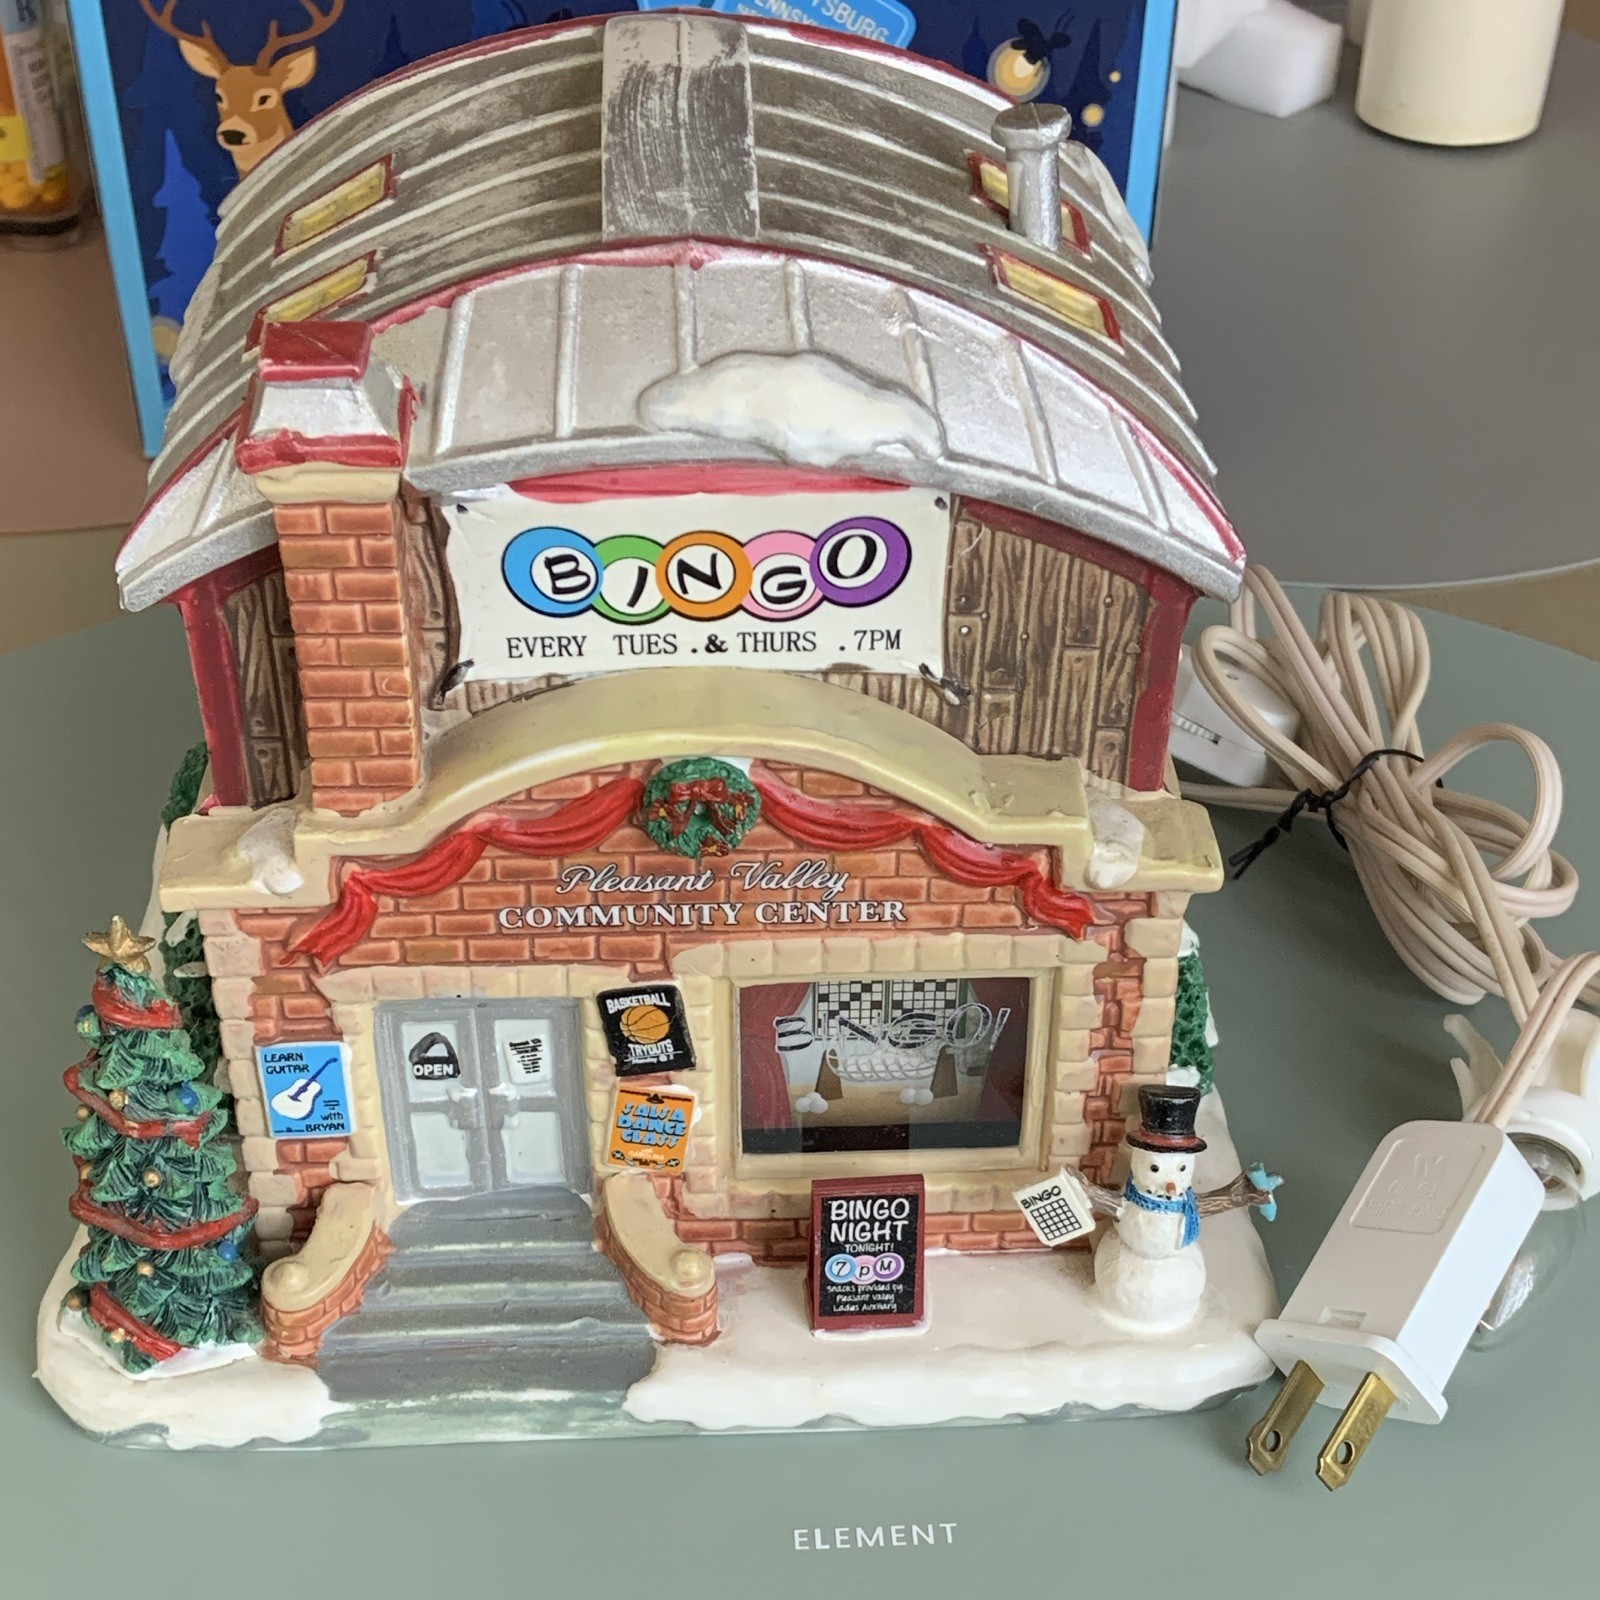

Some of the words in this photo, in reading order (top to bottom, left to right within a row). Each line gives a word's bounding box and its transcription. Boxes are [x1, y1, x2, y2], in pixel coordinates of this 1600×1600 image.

[812, 0, 890, 42] SBURG
[543, 533, 879, 609] BINGO
[506, 635, 588, 659] EVERY
[704, 633, 729, 654] &
[556, 862, 714, 894] Pleasant
[730, 860, 850, 899] Valley
[498, 902, 744, 929] COMMUNITY
[754, 900, 908, 925] CENTER
[605, 992, 671, 1014] BASKETBALL
[264, 1052, 304, 1063] LEARN
[627, 1039, 674, 1057] TRYOUTS
[265, 1064, 310, 1075] GUITAR
[413, 1063, 454, 1076] OPEN
[621, 1102, 686, 1123] SALSA
[305, 1122, 346, 1133] BRYAN
[616, 1115, 687, 1137] DANCE
[620, 1128, 680, 1149] CLASS
[1020, 1185, 1062, 1210] BINGO
[828, 1198, 910, 1221] BINGO
[830, 1220, 910, 1243] NIGHT
[844, 1243, 895, 1254] TONIGHT!
[793, 1522, 957, 1550] ELEMENT
